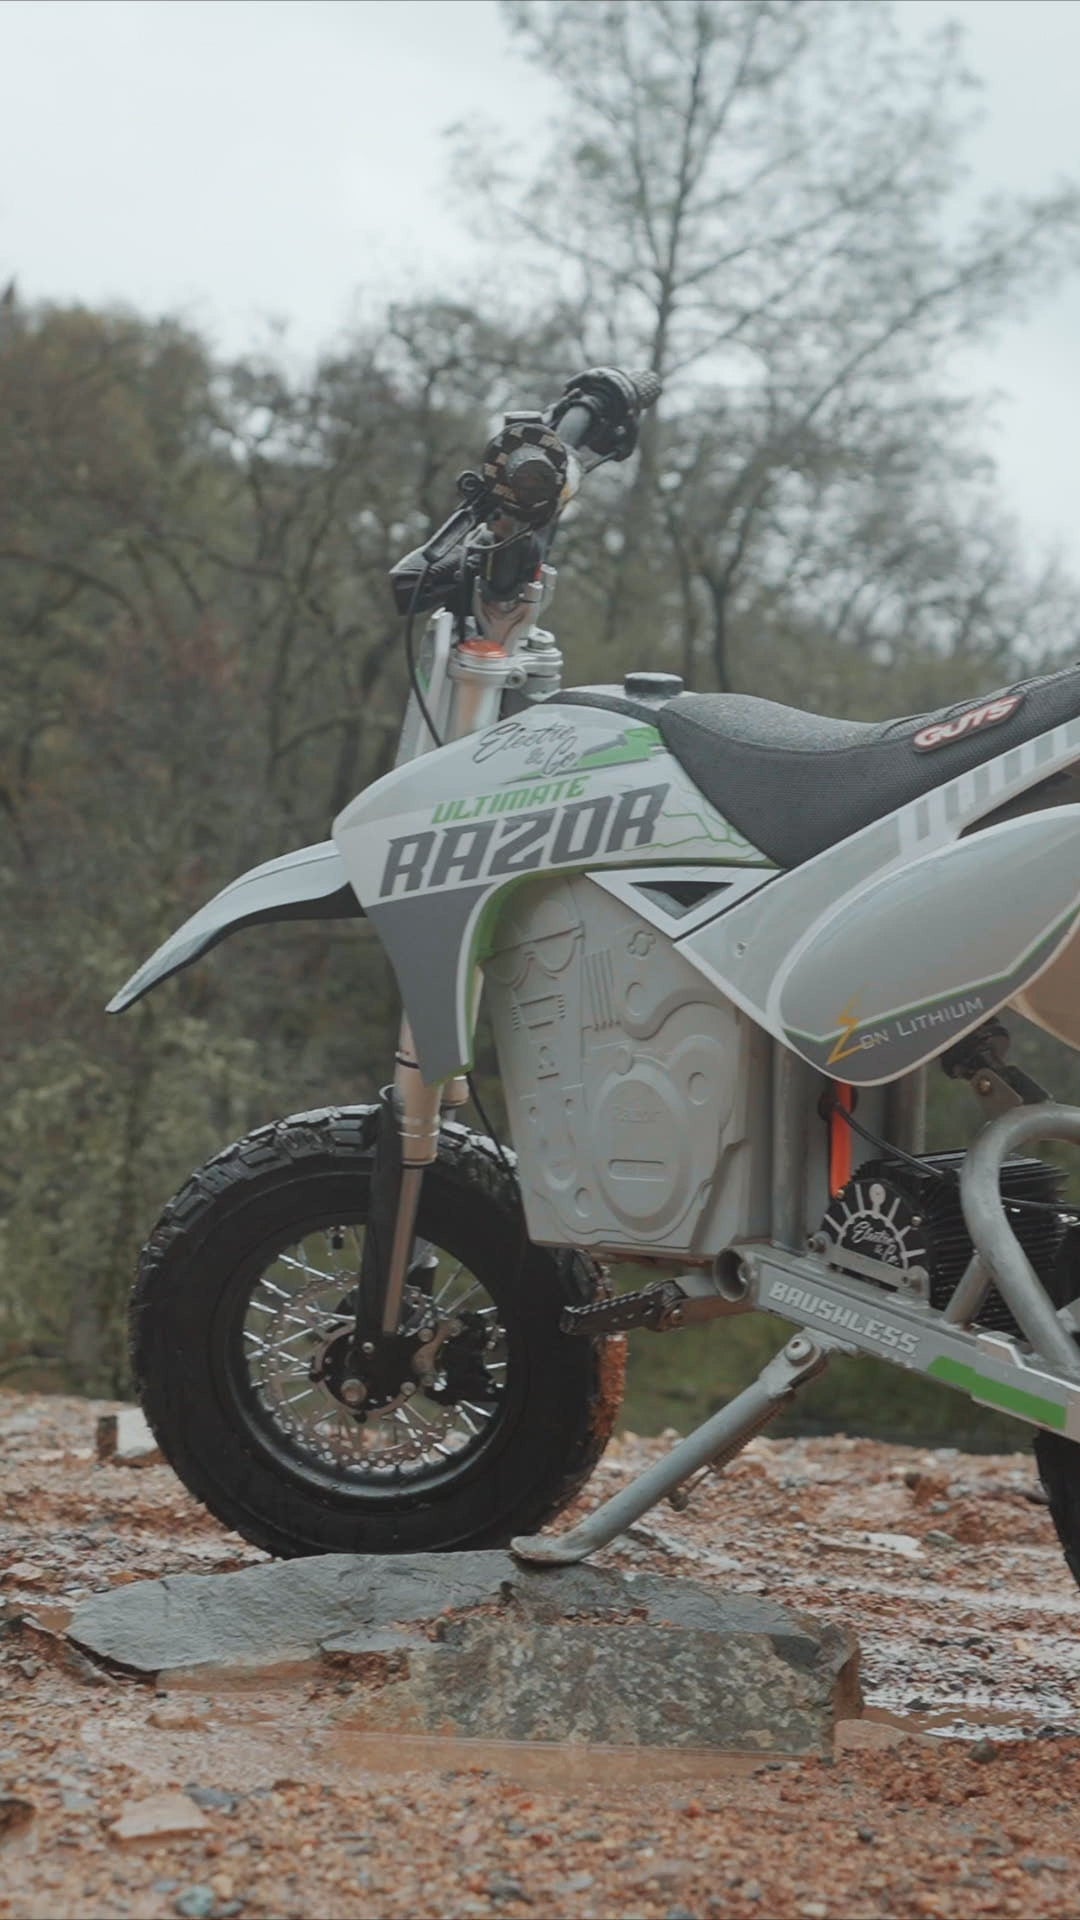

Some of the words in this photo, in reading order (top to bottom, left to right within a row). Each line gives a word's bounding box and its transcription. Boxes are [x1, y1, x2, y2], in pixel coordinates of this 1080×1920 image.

[914, 697, 1019, 746] GUTS
[430, 775, 592, 825] ULTIMATE
[379, 782, 671, 899] RAZOR
[895, 997, 985, 1037] LITHIUM
[768, 1280, 921, 1355] BRUSHLESS
